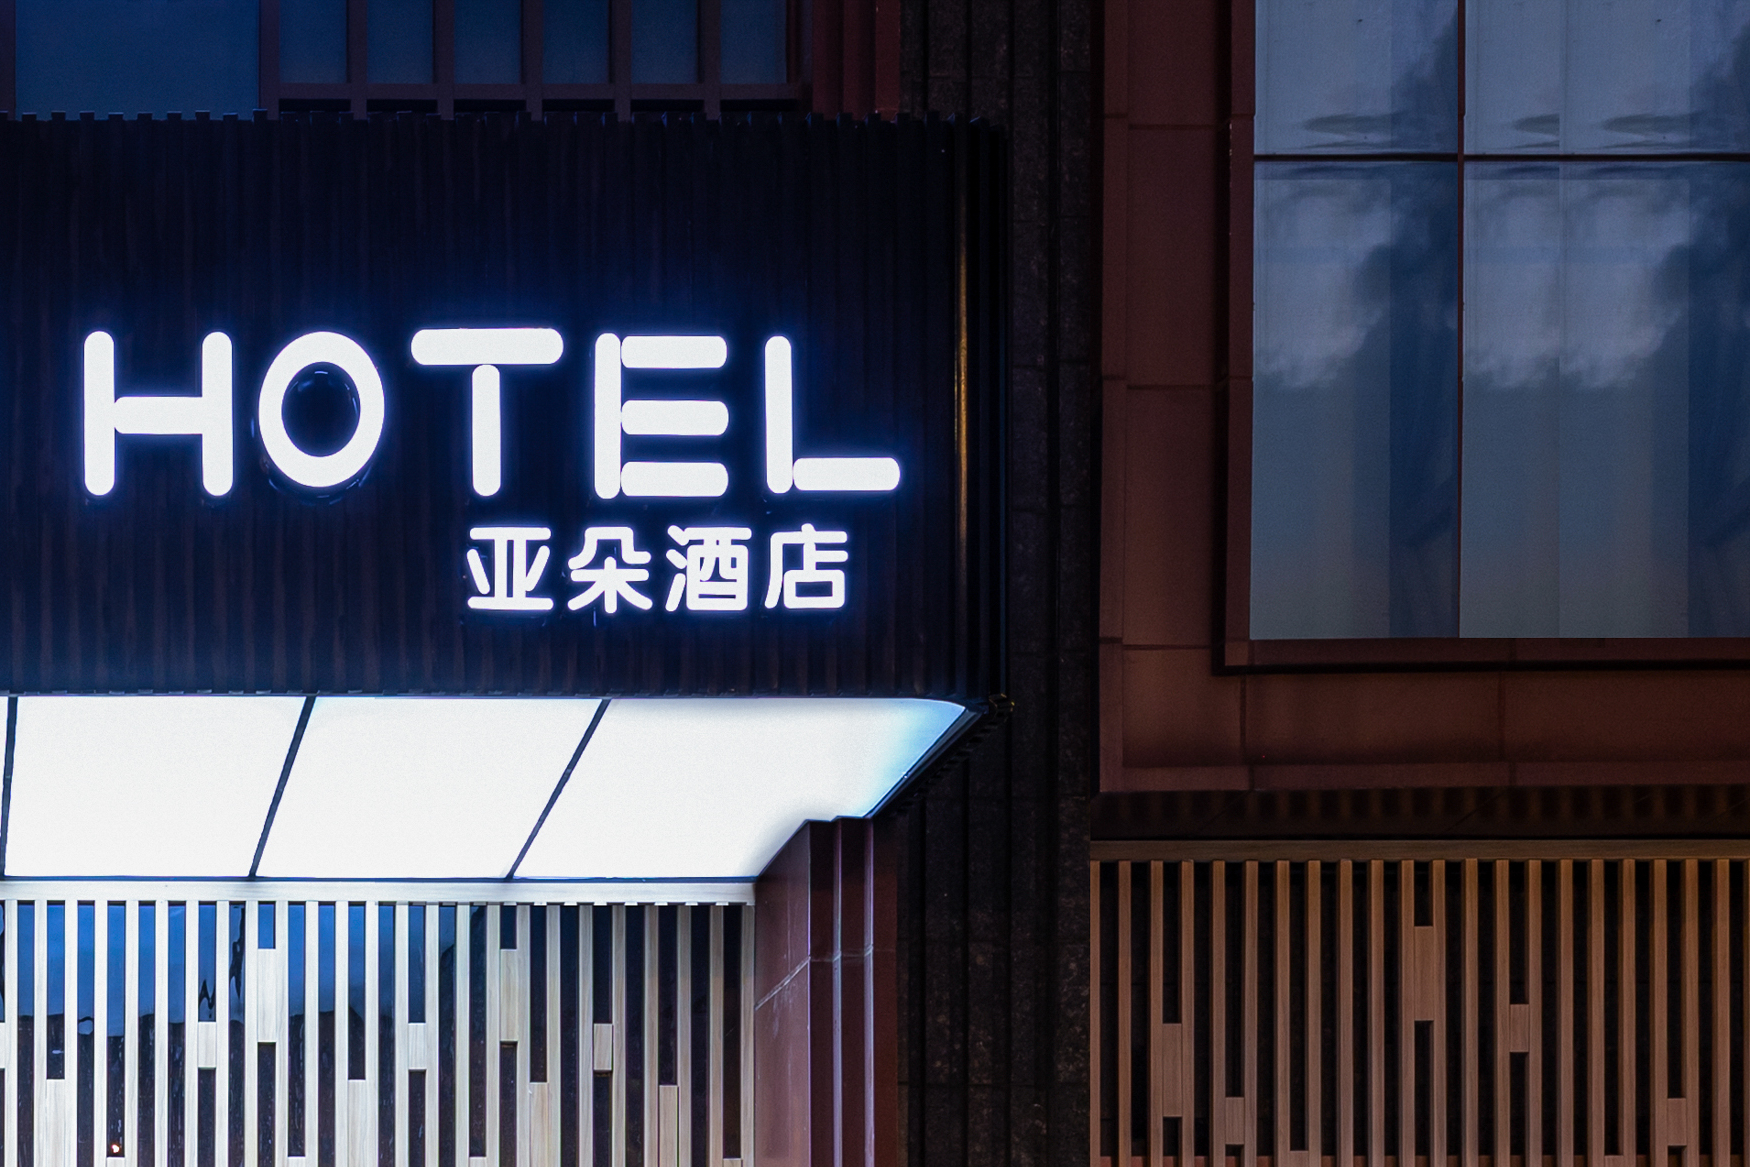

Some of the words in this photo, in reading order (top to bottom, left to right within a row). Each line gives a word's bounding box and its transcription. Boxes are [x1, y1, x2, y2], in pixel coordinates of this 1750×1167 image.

[84, 328, 901, 499] HOTEL
[466, 523, 849, 614] 亚朵酒店
